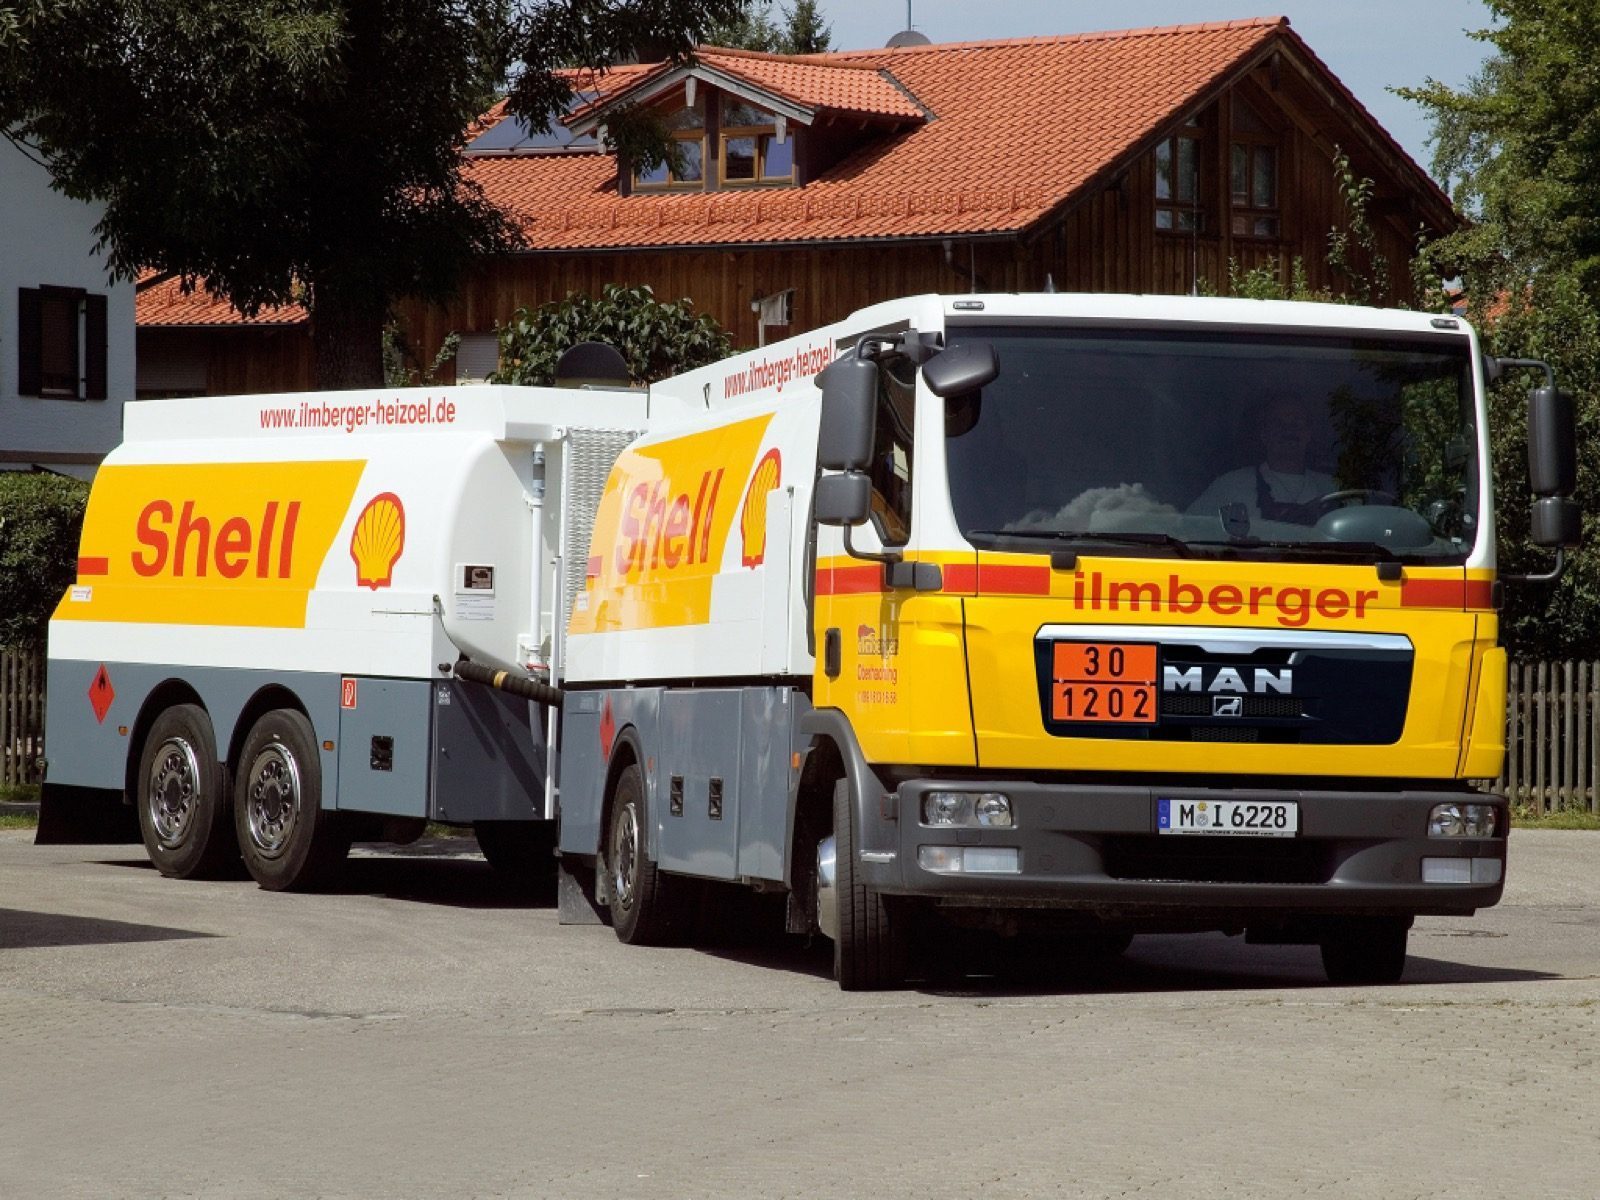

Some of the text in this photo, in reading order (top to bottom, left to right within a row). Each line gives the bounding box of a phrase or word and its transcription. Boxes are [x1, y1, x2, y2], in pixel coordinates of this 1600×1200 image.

[260, 397, 456, 433] www.ilmberger-heizoel.de
[616, 467, 725, 575] Shell
[131, 500, 302, 579] Shell
[1074, 571, 1379, 627] ilmberger
[1083, 646, 1125, 677] 30
[1163, 665, 1293, 694] MAN
[1062, 687, 1149, 718] 1202
[1180, 804, 1287, 828] M I 6228
